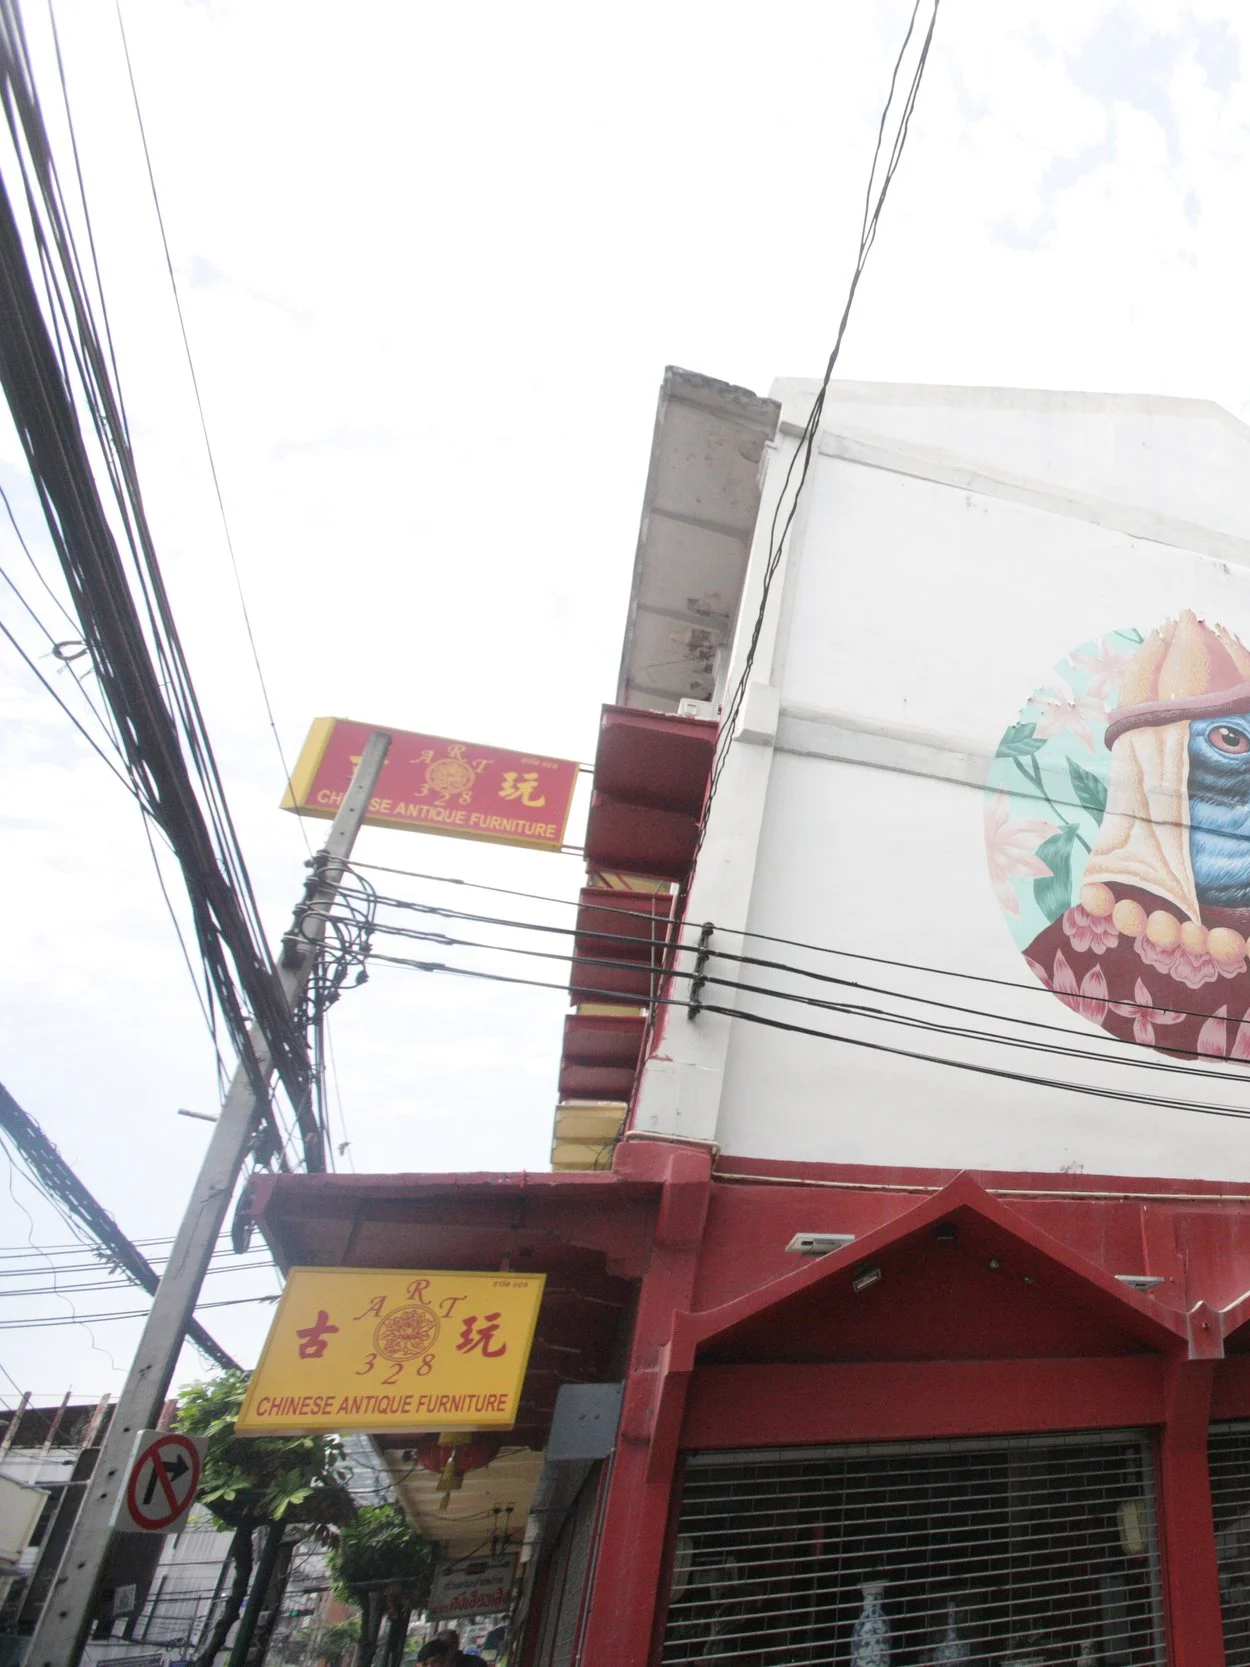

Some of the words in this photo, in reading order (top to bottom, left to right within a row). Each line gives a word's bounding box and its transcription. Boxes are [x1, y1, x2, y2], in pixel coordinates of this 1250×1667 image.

[499, 771, 546, 808] 玩
[317, 789, 392, 814] CHSE
[394, 802, 468, 826] ANTIQUE
[469, 813, 557, 838] FURNITURE
[296, 1310, 340, 1360] 古
[456, 1312, 507, 1358] 玩
[256, 1396, 336, 1417] CHINESE
[337, 1396, 414, 1415] ANTIQUE
[415, 1394, 509, 1414] FURNITURE
